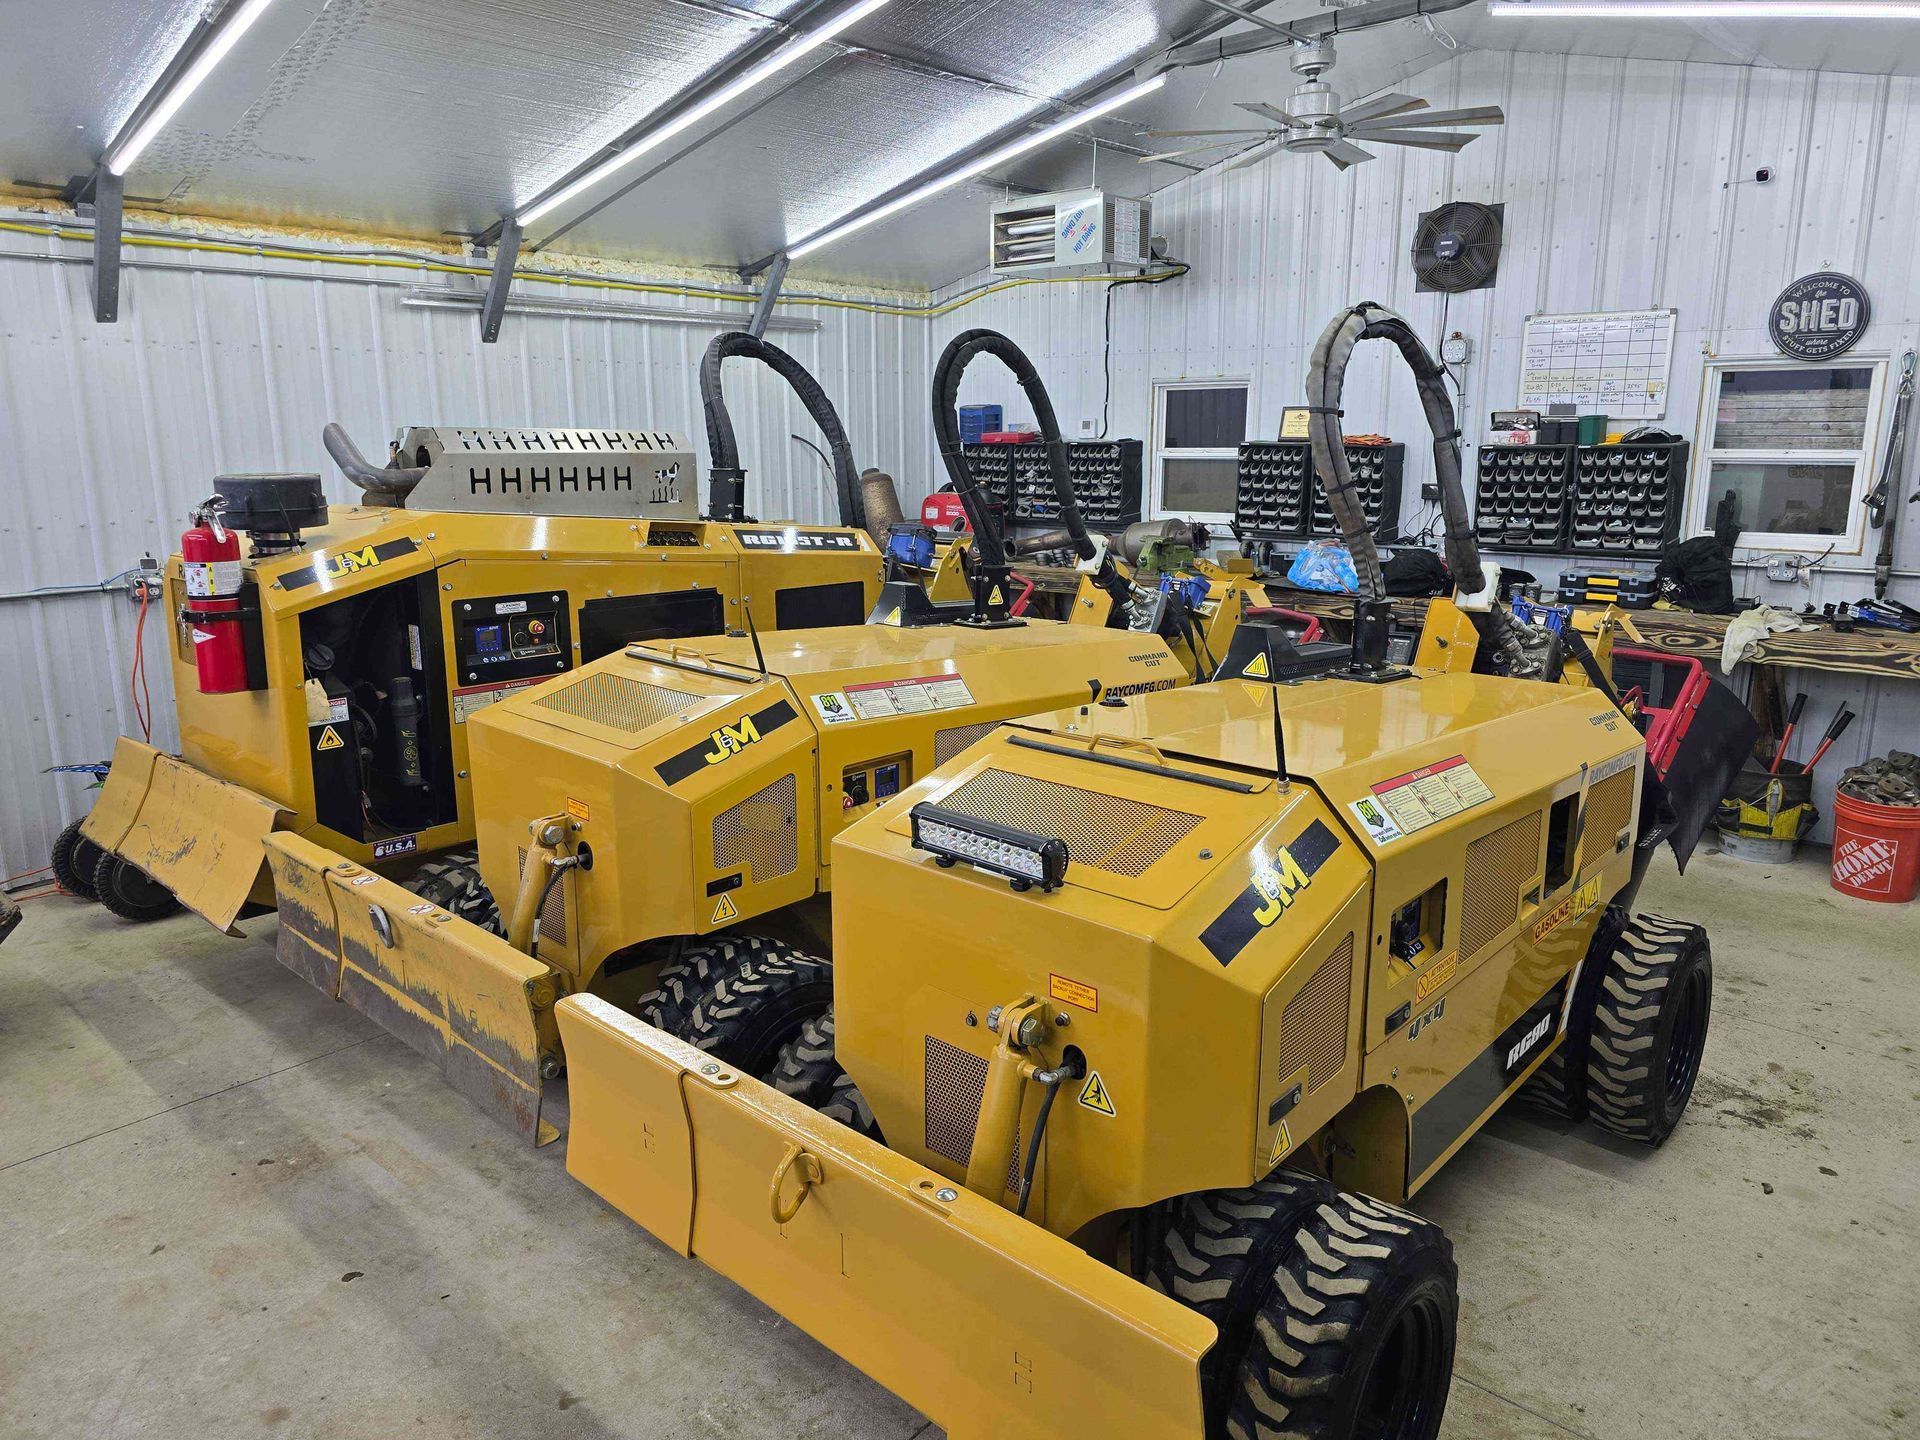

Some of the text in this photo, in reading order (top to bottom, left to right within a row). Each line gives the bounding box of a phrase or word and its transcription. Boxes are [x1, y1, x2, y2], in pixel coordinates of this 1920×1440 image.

[1061, 208, 1085, 239] HOT DAWG
[1073, 223, 1097, 254] HOT DAWG
[1792, 281, 1851, 298] WELCOME TO
[1814, 289, 1828, 299] the
[1779, 297, 1860, 334] SHED
[1782, 330, 1854, 354] STUFF GETS FIXED
[1805, 338, 1829, 346] where
[328, 545, 381, 578] J&M
[1128, 651, 1169, 663] COMMAND
[1144, 660, 1161, 668] CUT
[510, 680, 531, 688] DANGER
[1104, 679, 1177, 699] RAYCOMFG.COM
[819, 694, 839, 707] 811
[1589, 710, 1619, 726] COMMAND
[1604, 721, 1618, 731] CUT
[704, 714, 762, 765] J&M
[1589, 749, 1638, 784] RAYCOMFG.COM
[1356, 799, 1379, 819] 811
[1839, 839, 1862, 858] THE
[1833, 840, 1896, 881] HOME
[1849, 859, 1893, 887] DEPOT
[1249, 845, 1311, 928] J&M
[1535, 900, 1570, 940] GASOLINE
[1068, 990, 1095, 1002] CONNECTION
[1506, 1012, 1551, 1070] RG80
